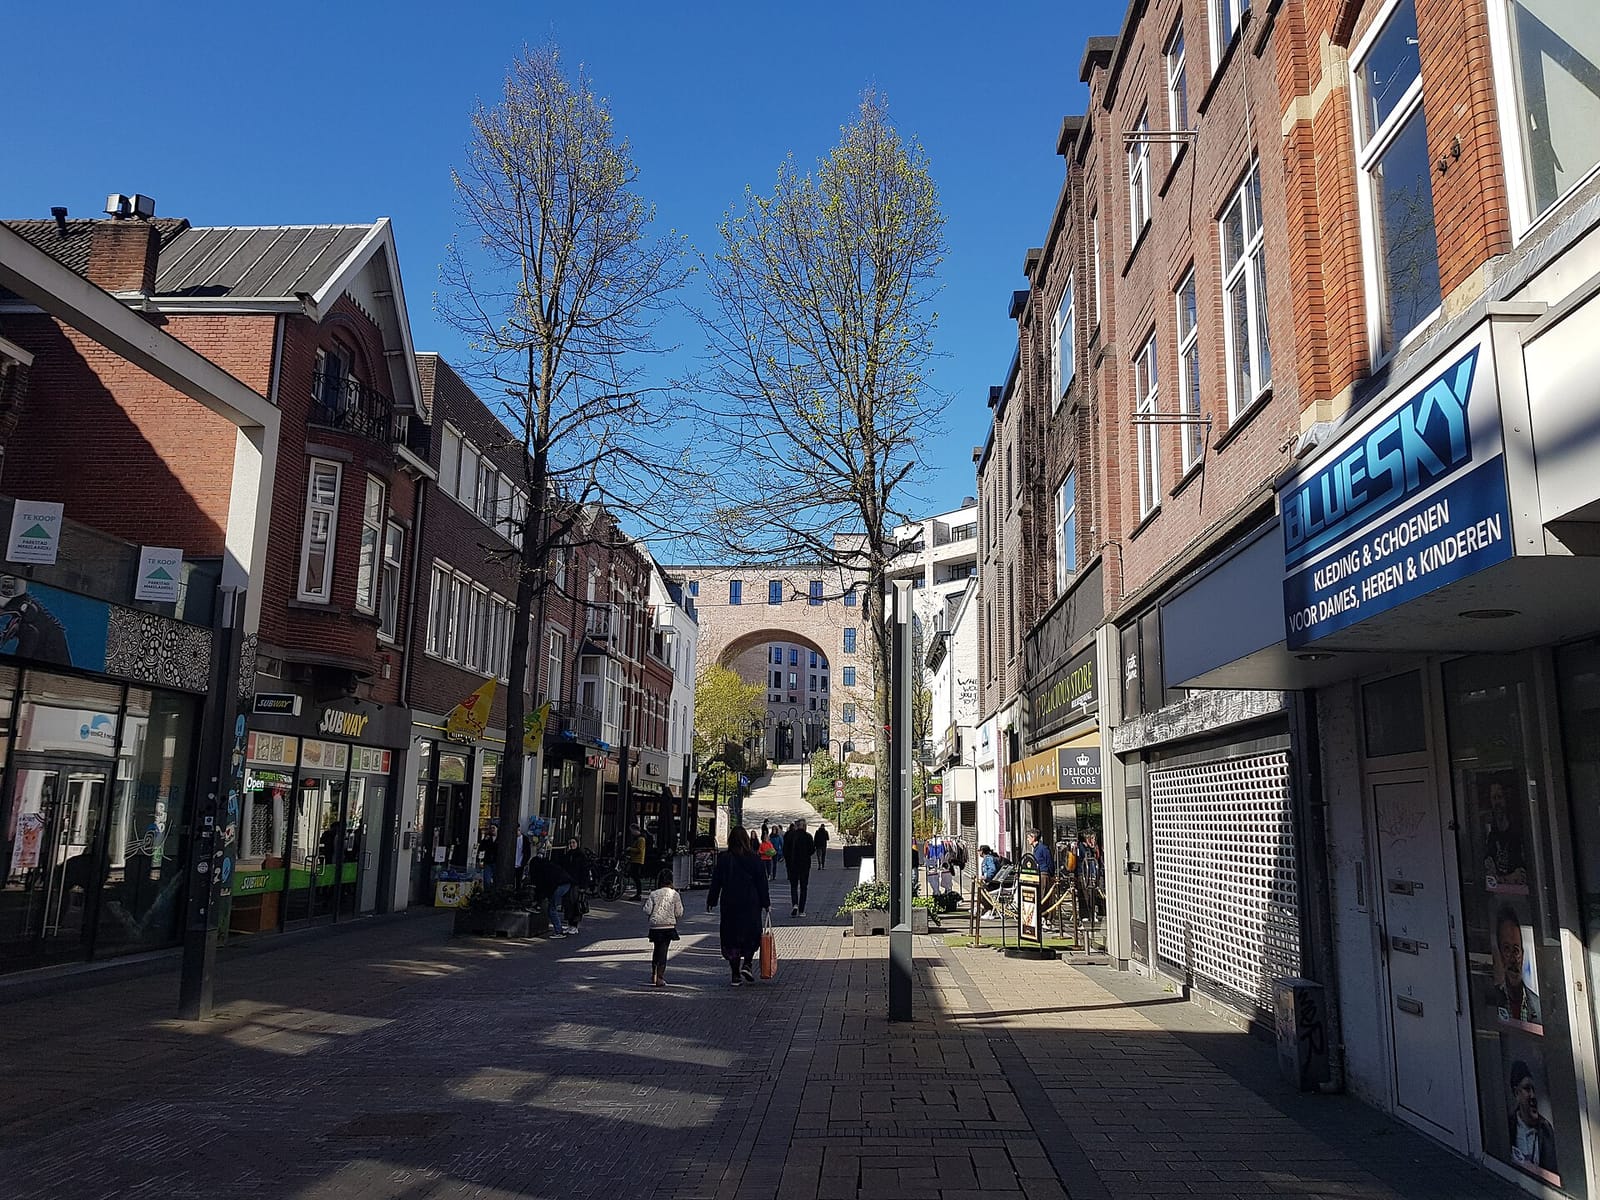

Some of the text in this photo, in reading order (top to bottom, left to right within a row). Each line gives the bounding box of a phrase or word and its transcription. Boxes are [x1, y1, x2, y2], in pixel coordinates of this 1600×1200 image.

[1285, 355, 1474, 549] BLUESKY
[23, 513, 56, 522] TE KOOP
[1313, 499, 1450, 592] KLEDING & SCHOENEN
[1288, 513, 1502, 633] VOOR DAMES, HEREN & KINDEREN
[1070, 660, 1093, 699] STORE
[257, 699, 292, 708] SUBWAY
[320, 708, 369, 737] SUBWAY
[1062, 766, 1101, 777] DELICIOU
[246, 777, 265, 789] Open
[1071, 776, 1096, 786] STORE
[241, 873, 271, 890] SUBWAY
